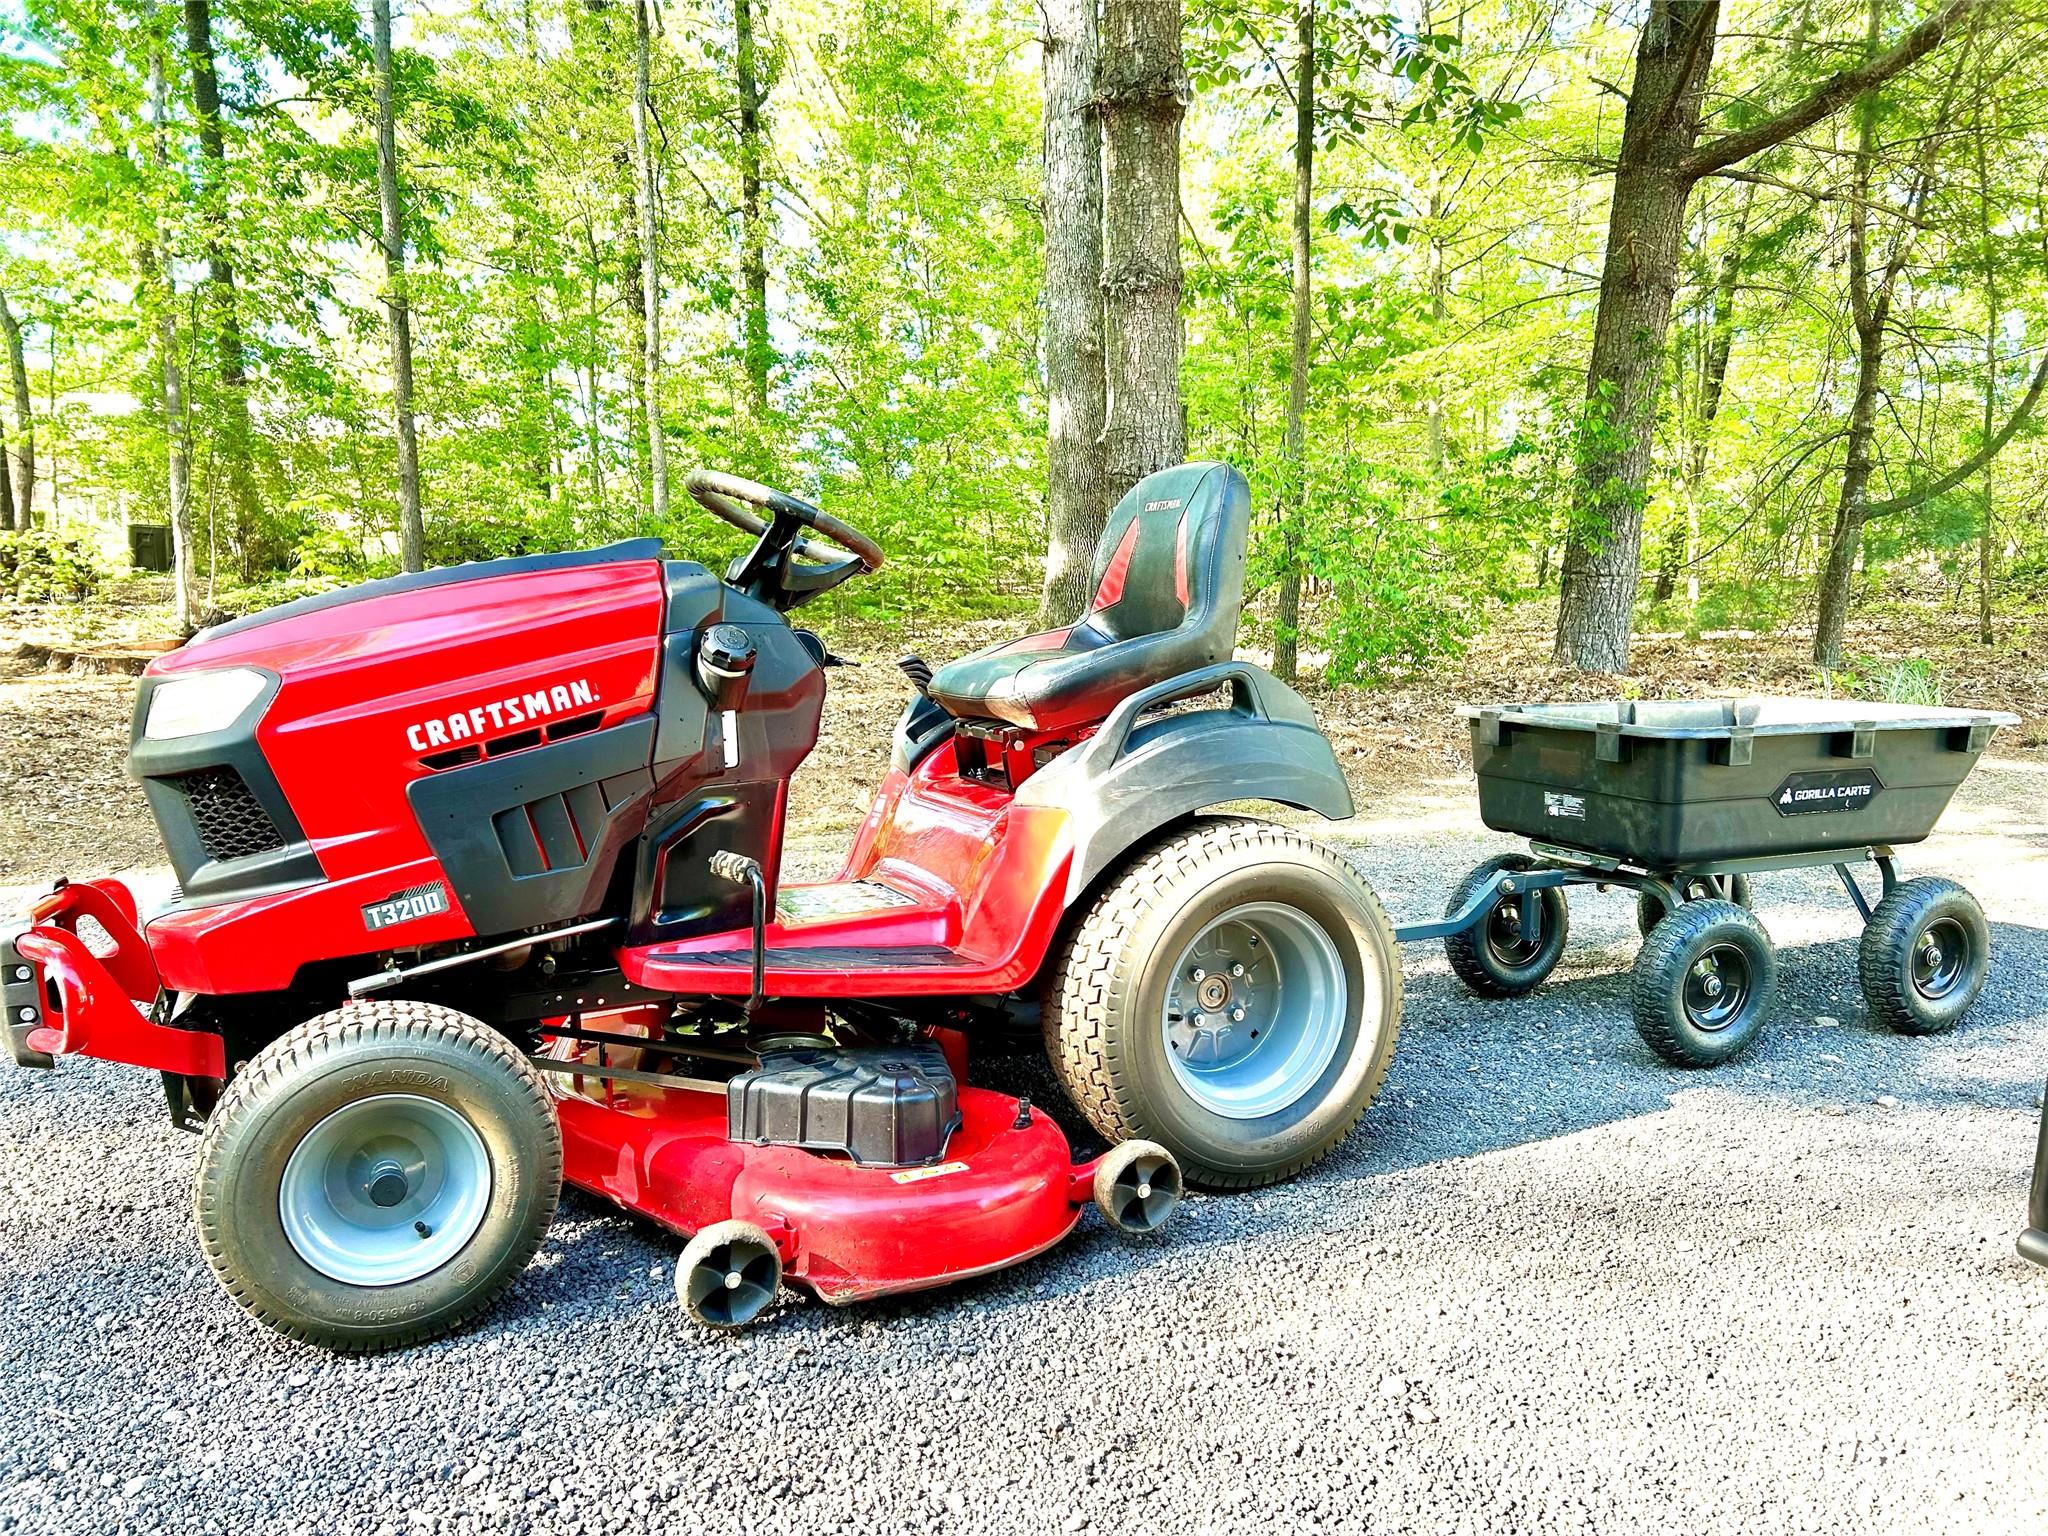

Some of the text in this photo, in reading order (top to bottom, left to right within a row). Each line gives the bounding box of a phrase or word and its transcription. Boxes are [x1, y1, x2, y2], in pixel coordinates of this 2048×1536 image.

[1145, 498, 1181, 512] CRAFTSMAN
[1794, 785, 1871, 801] GORILLA CARTS
[367, 892, 441, 927] T3200
